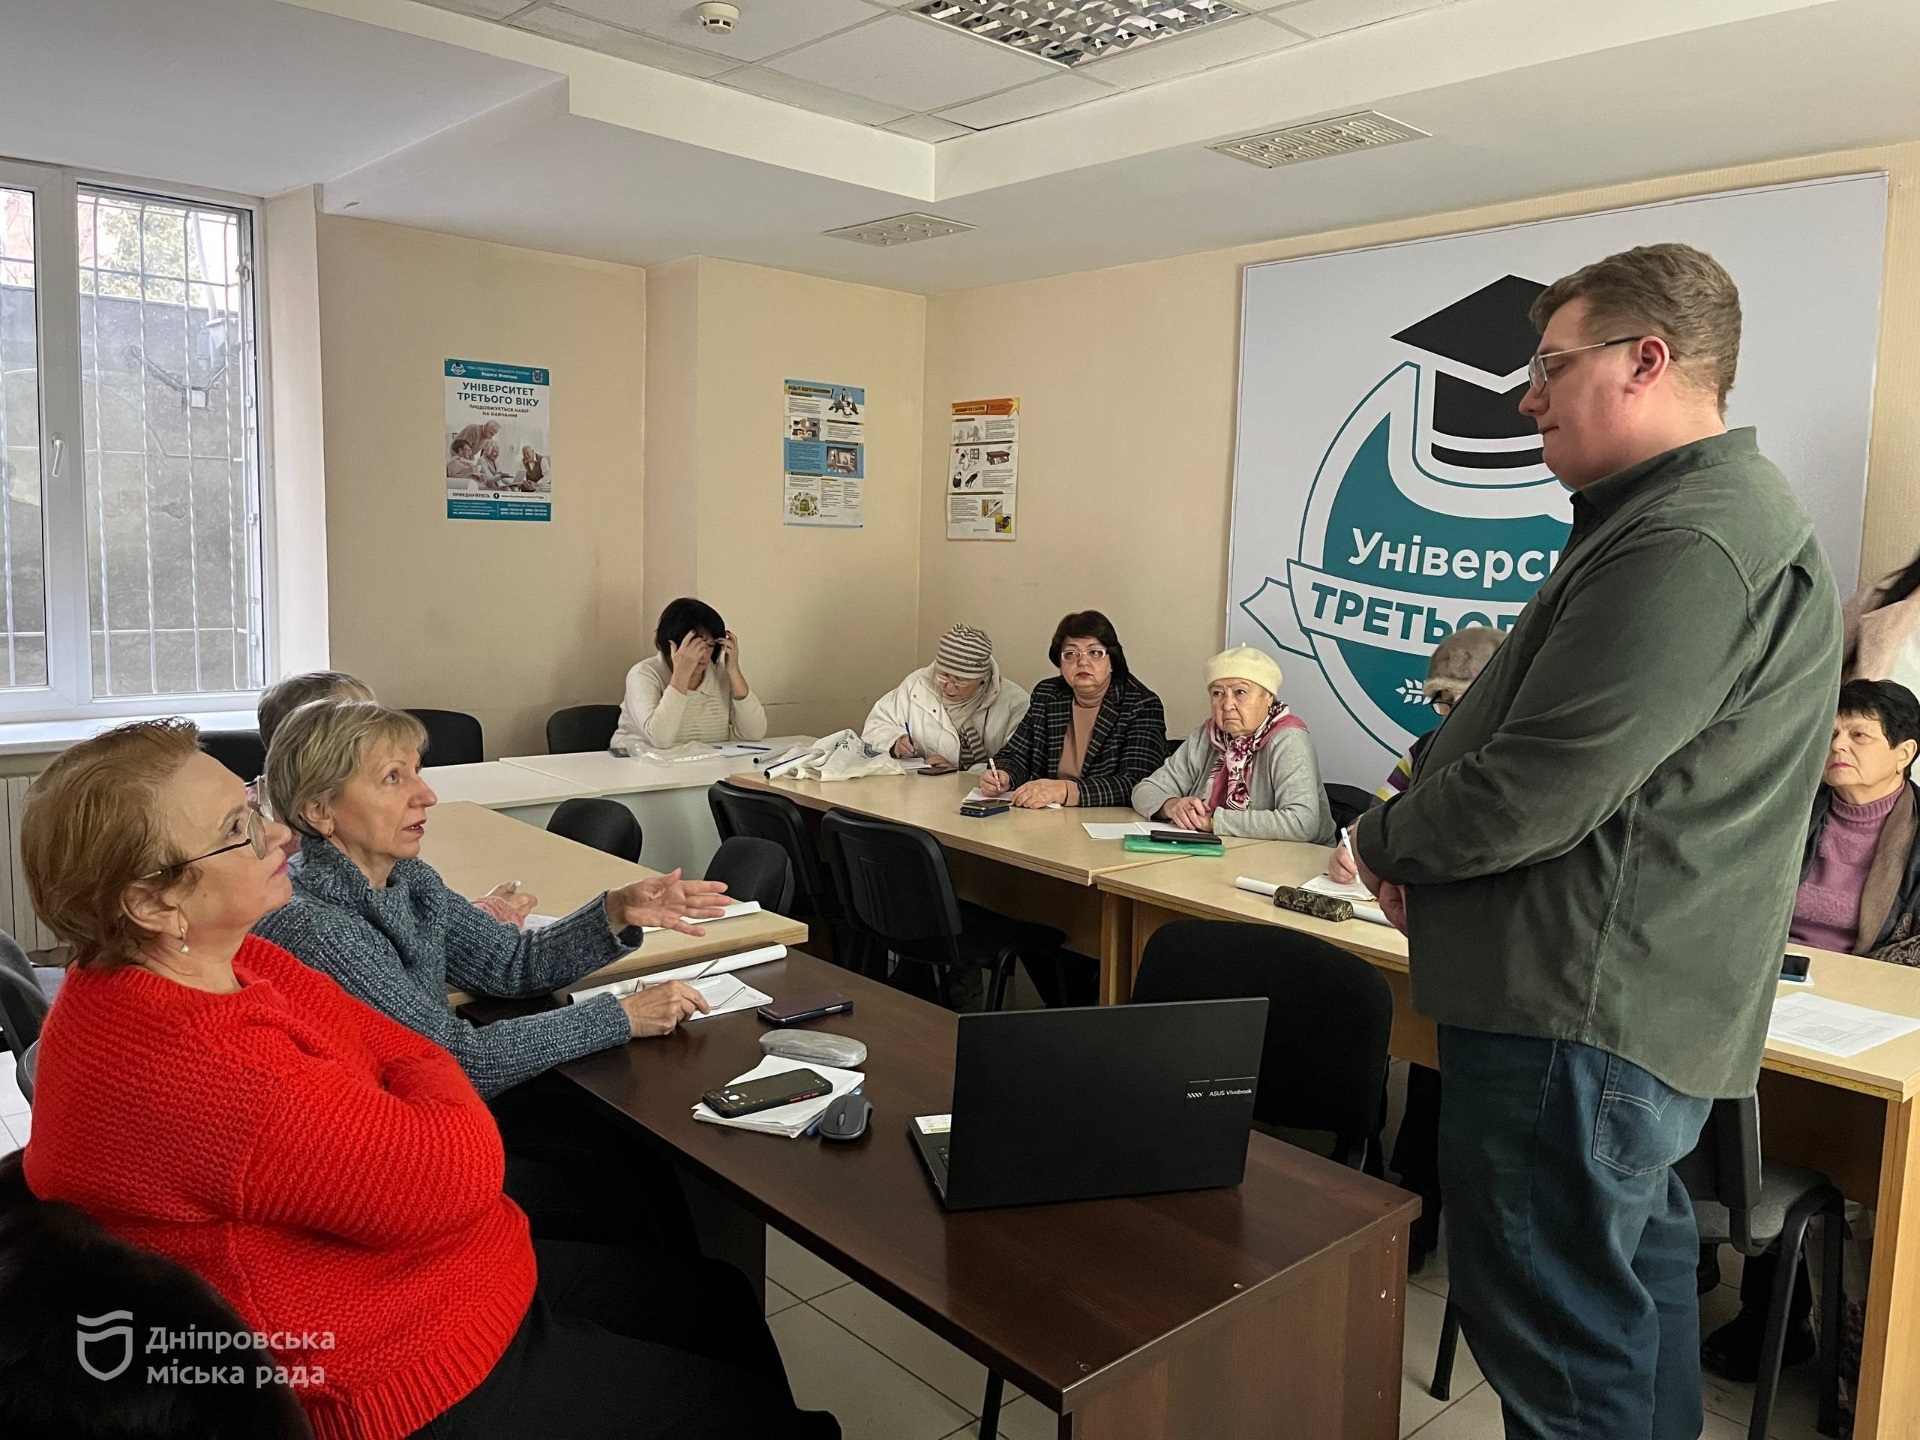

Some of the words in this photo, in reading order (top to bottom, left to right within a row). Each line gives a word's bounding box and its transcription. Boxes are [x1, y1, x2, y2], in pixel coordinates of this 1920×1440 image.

[462, 382, 535, 396] УНІВЕРСИТЕТ
[457, 392, 512, 404] ТРЕТЬОГО
[515, 397, 540, 407] ВІКУ
